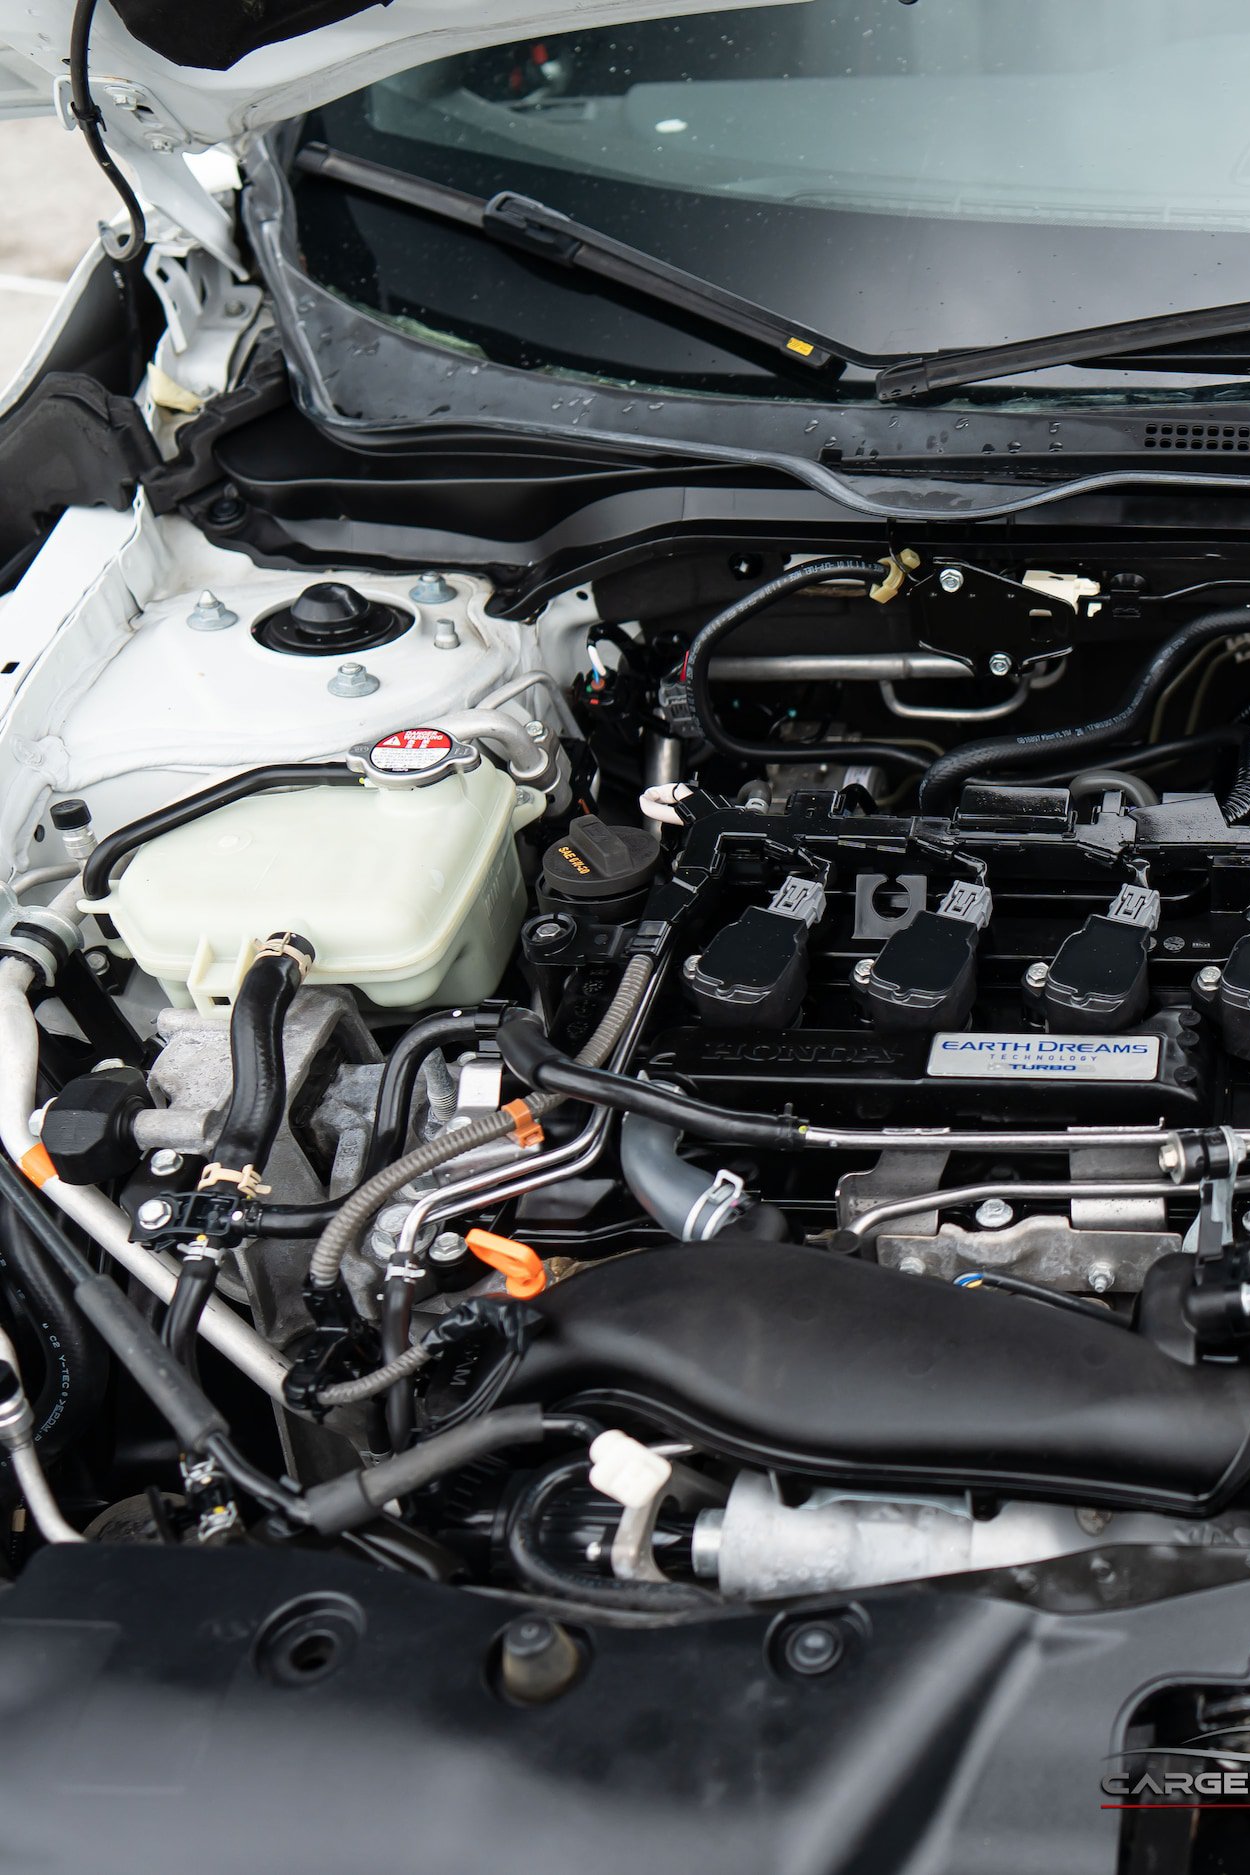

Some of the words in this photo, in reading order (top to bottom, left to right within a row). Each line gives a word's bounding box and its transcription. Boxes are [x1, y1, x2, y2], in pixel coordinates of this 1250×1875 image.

[701, 1043, 896, 1063] HONDA
[942, 1040, 1031, 1052] EARTH
[1038, 1040, 1149, 1055] DREAMS
[989, 1053, 1098, 1062] TECHNOLOGY
[1008, 1063, 1077, 1072] TURBO
[59, 1354, 70, 1390] Y-TEC
